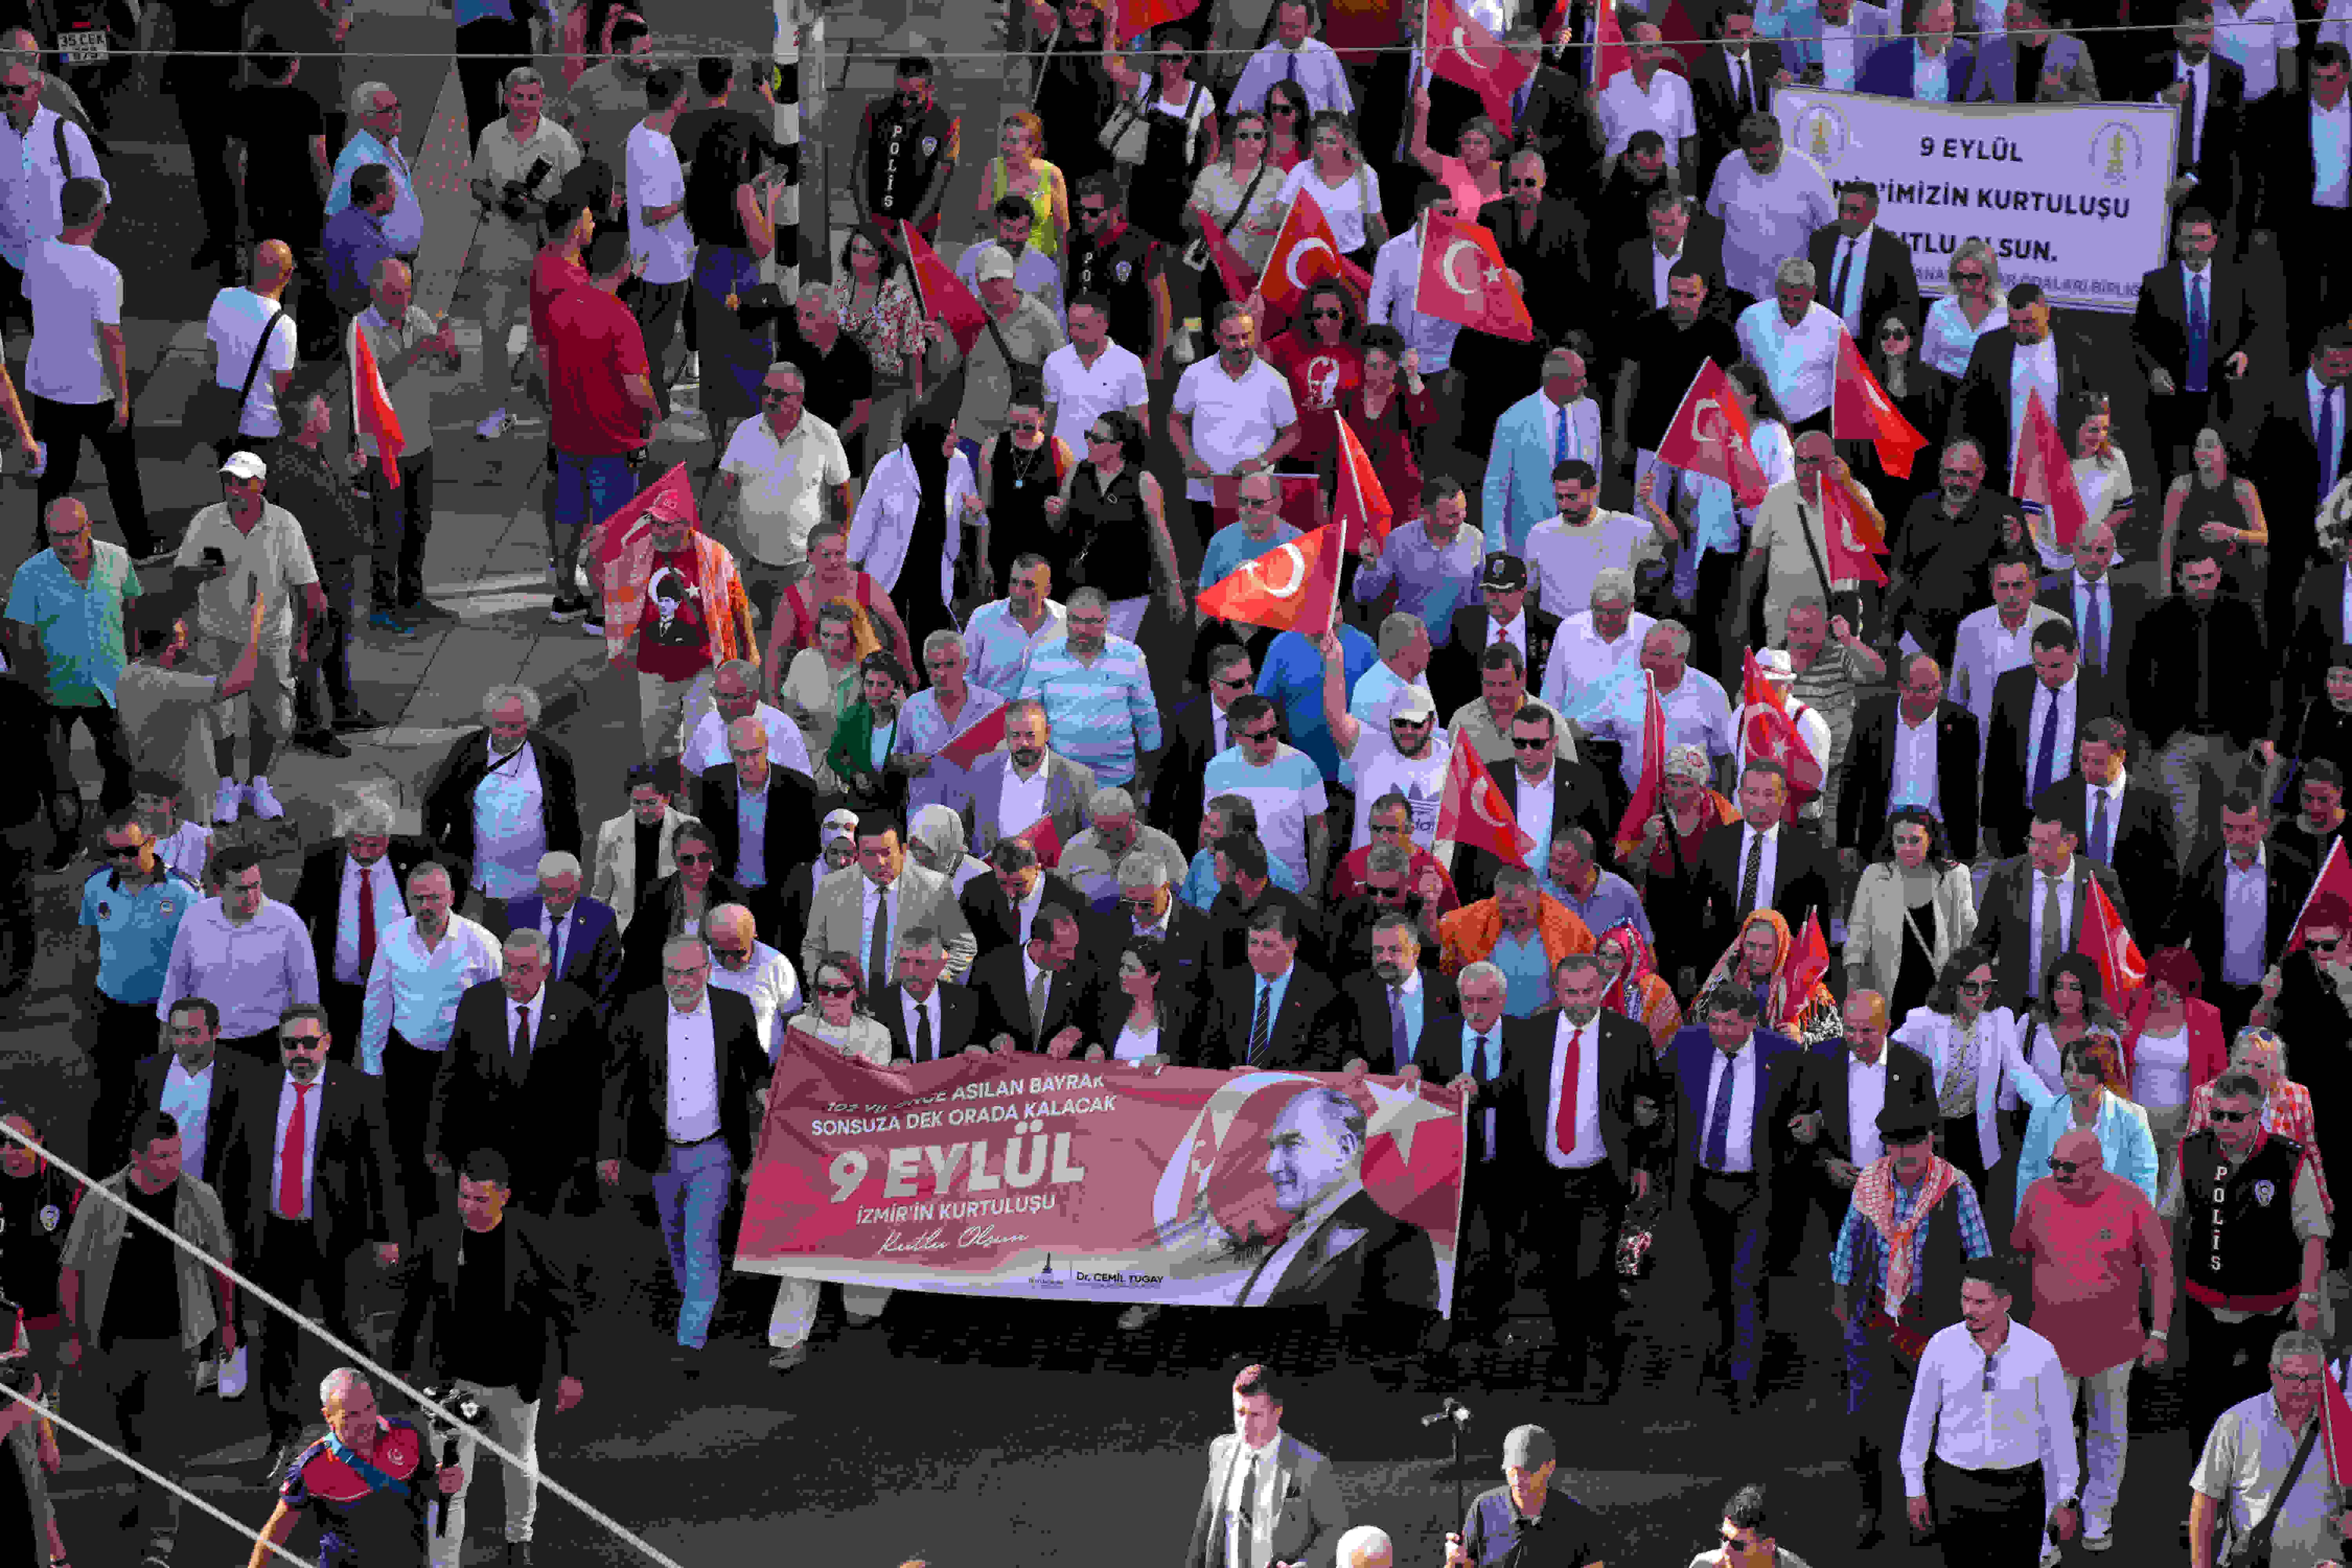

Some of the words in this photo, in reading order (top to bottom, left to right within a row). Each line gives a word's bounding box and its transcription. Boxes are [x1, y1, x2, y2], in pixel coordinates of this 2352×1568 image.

[1920, 136, 1934, 157] 9
[1942, 136, 2023, 163] EYLÜL
[1978, 187, 2129, 221] KURTULUŞU
[951, 1078, 1024, 1101] ASILAN
[1029, 1074, 1104, 1094] BAYRAK
[812, 1116, 900, 1136] SONSUZA
[906, 1110, 944, 1130] DEK
[948, 1103, 1019, 1126] ORADA
[1024, 1095, 1116, 1120] KALACAK
[829, 1151, 869, 1203] 9
[881, 1119, 1085, 1199] EYLÜL
[940, 1194, 1056, 1219] KURTULUŞU
[2211, 1165, 2228, 1270] POLİS
